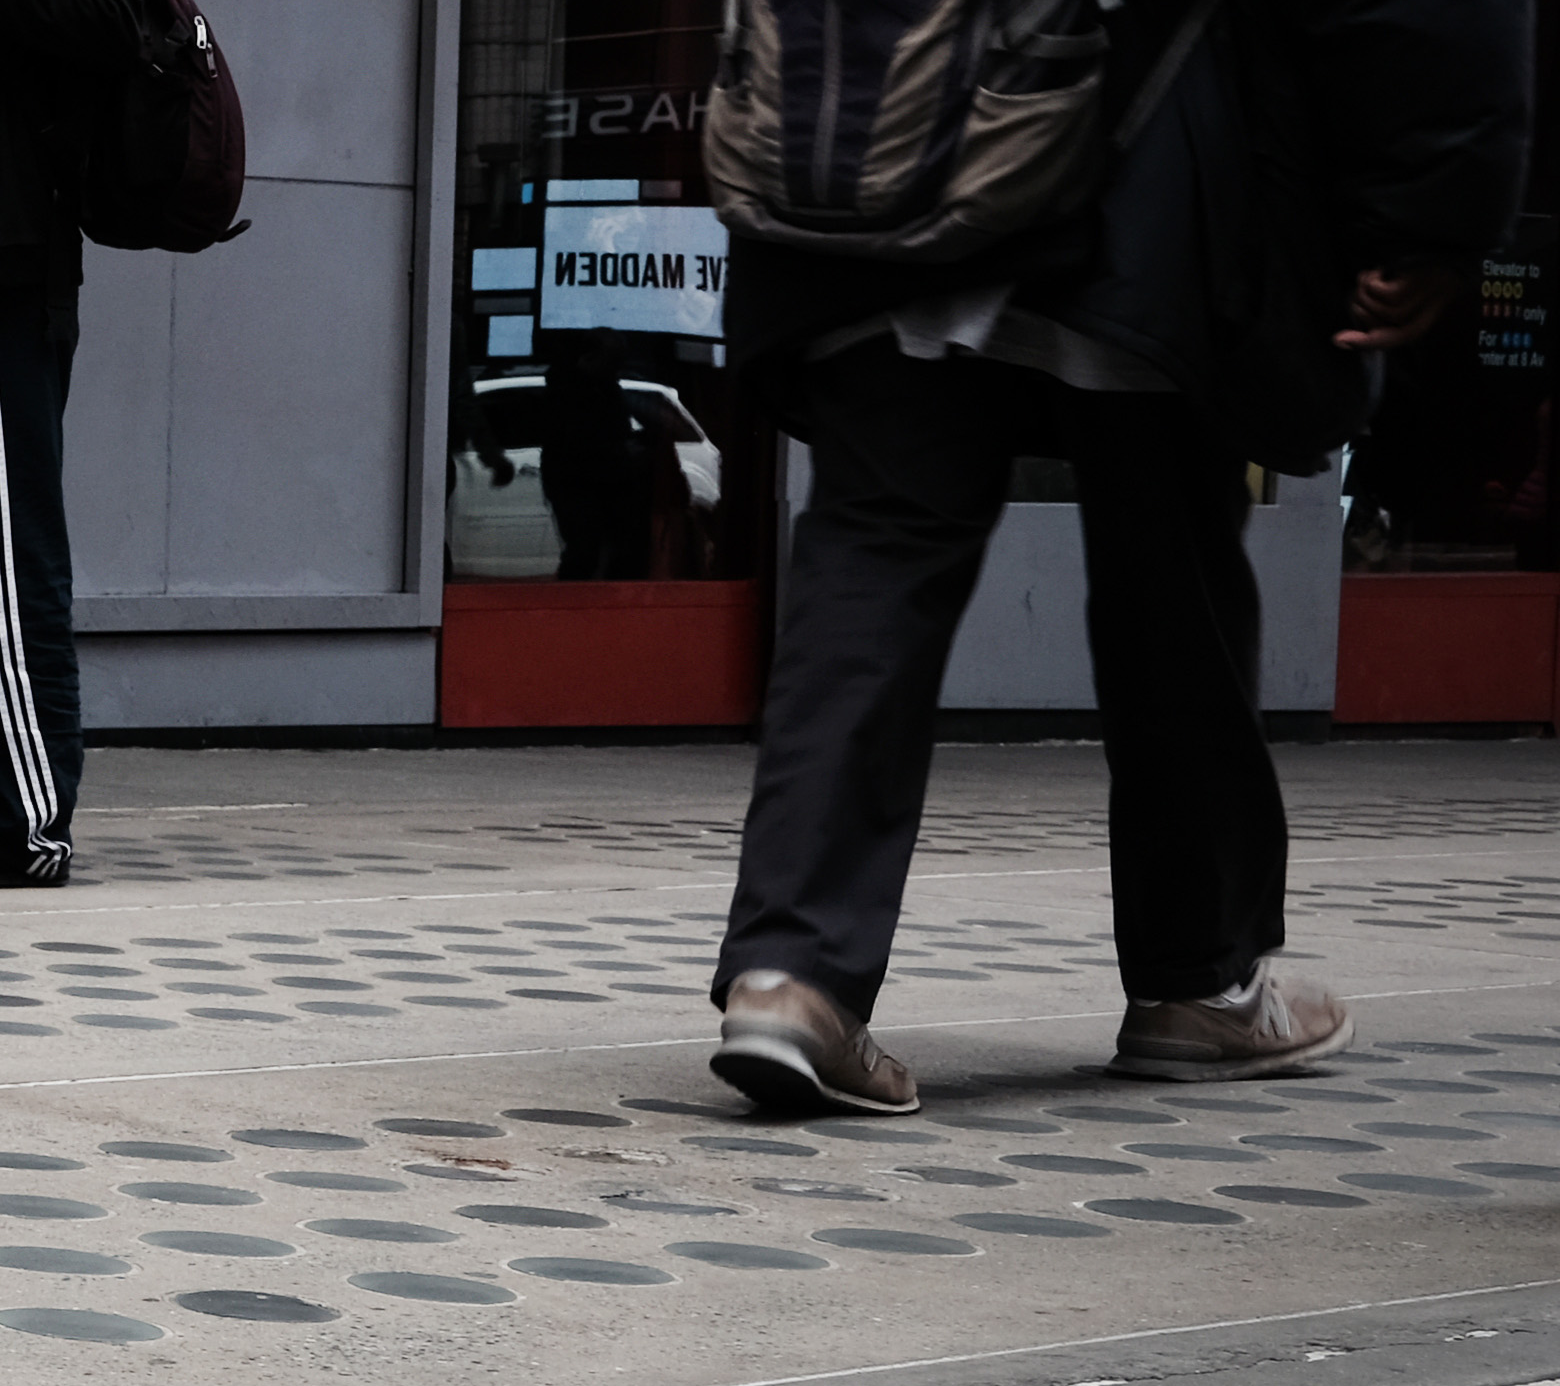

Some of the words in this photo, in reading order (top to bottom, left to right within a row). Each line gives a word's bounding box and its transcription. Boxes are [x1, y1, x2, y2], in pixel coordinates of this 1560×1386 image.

[1482, 259, 1527, 277] Elevator
[1529, 263, 1540, 279] to
[1523, 305, 1547, 325] only
[1478, 330, 1498, 347] For
